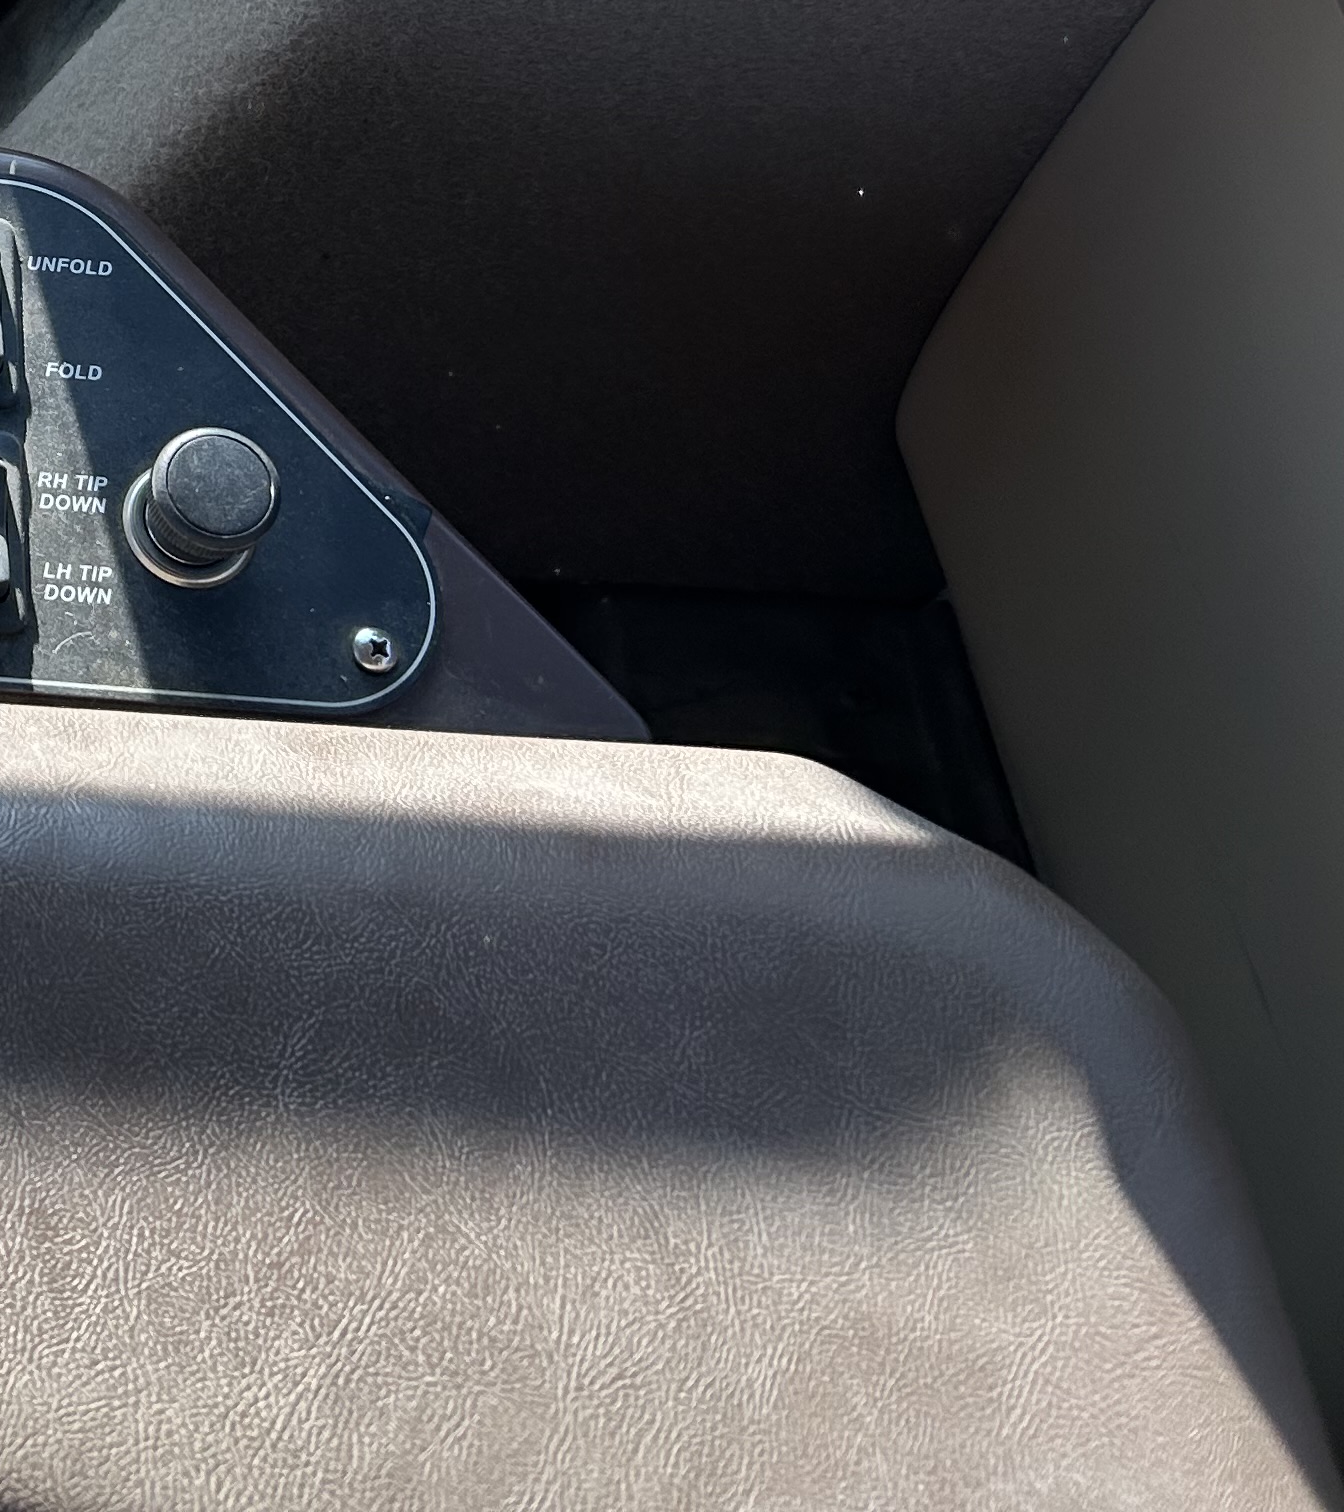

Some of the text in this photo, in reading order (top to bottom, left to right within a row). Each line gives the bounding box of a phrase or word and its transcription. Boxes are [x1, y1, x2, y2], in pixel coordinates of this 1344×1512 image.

[27, 256, 112, 276] UNFOLD
[45, 362, 102, 381] FOLD
[38, 472, 108, 491] RH TIP
[39, 494, 106, 514] DOWN
[42, 562, 112, 582] LH TIP
[43, 585, 112, 605] DOWN
